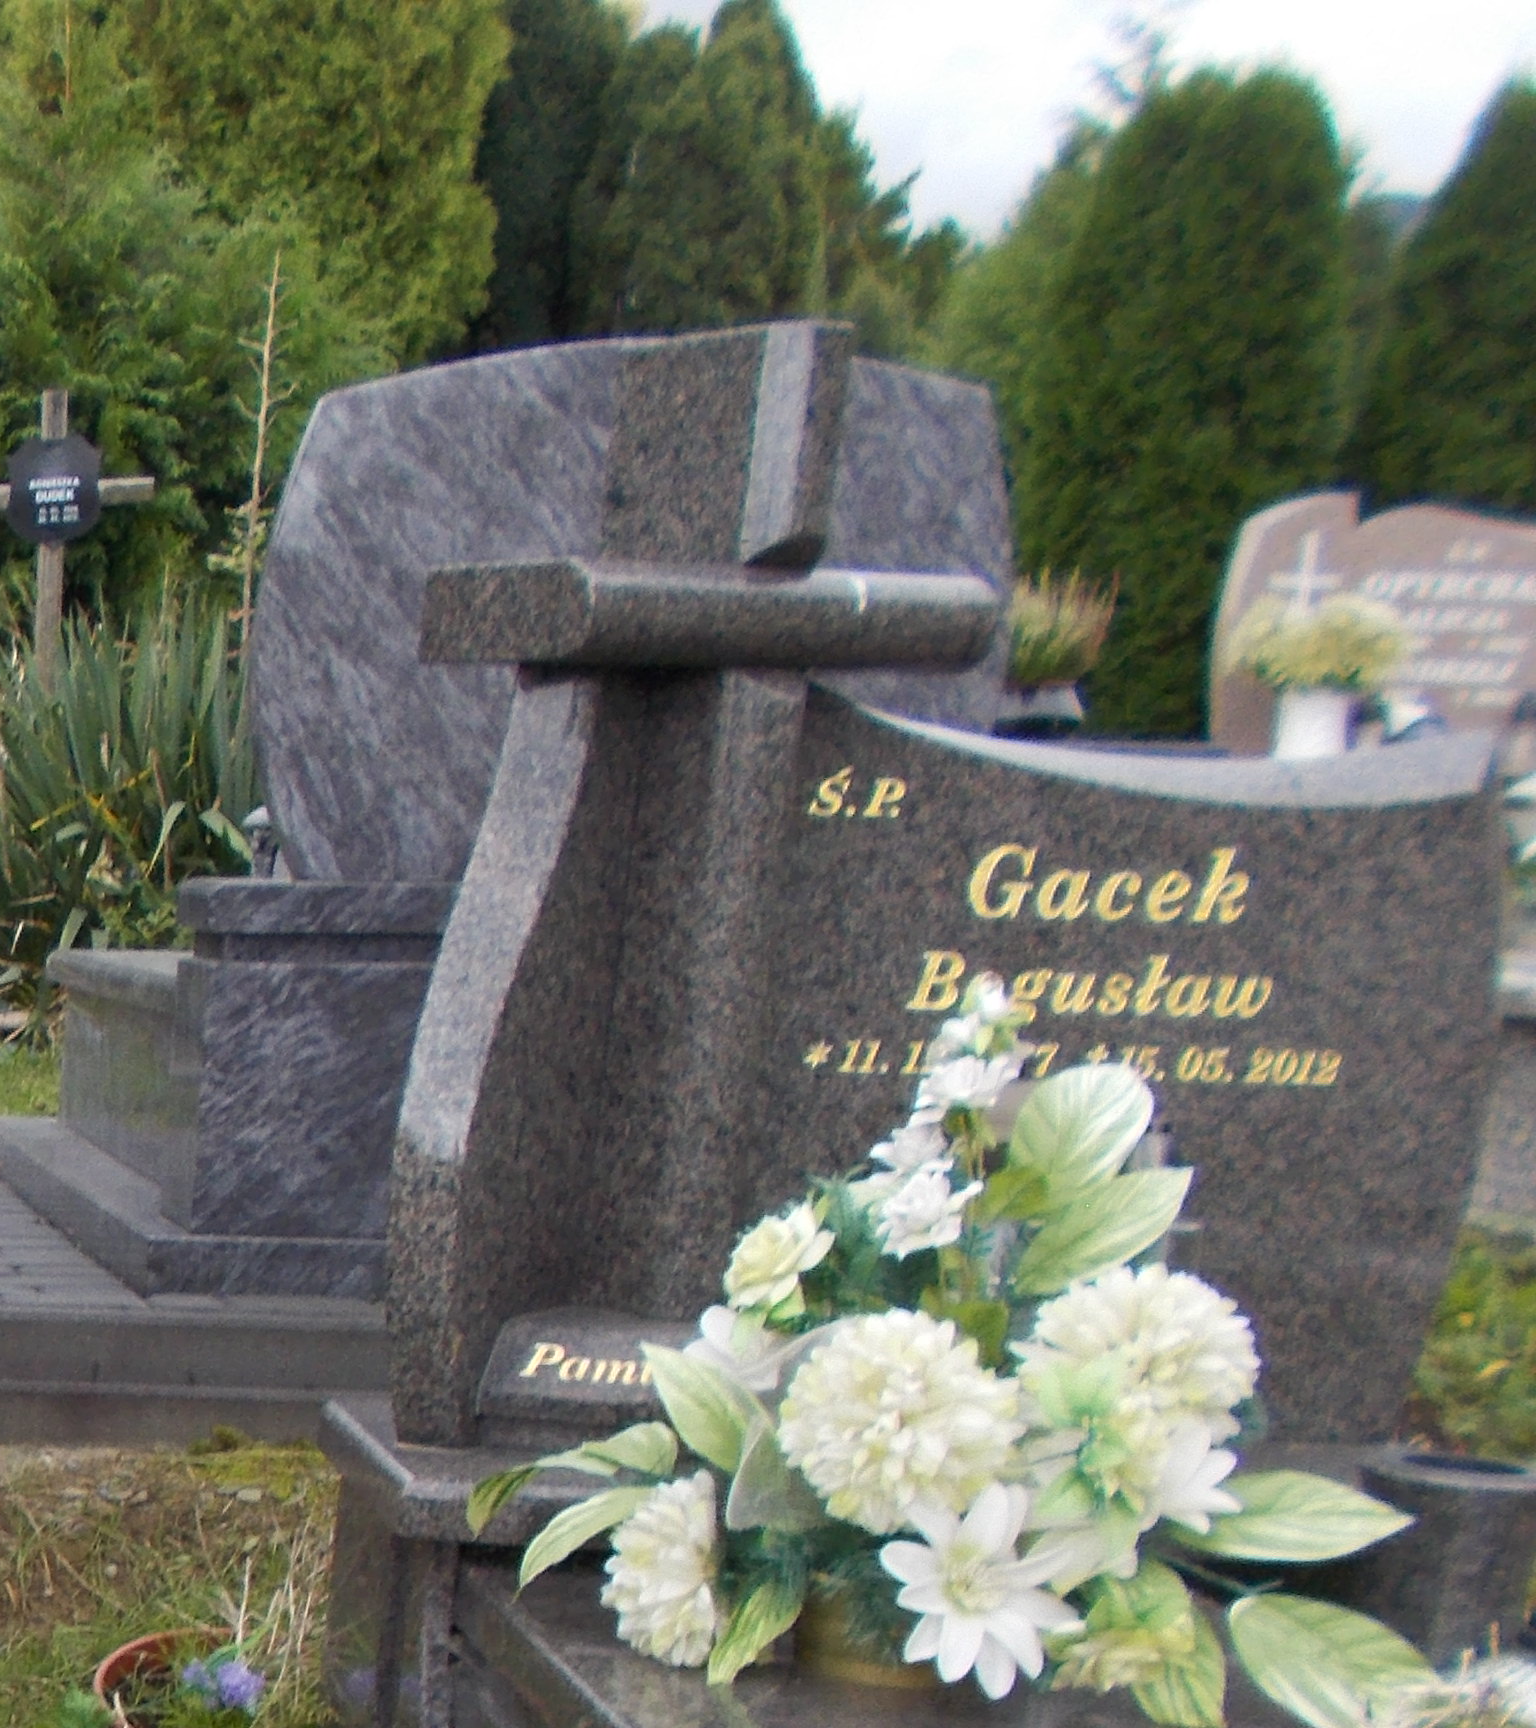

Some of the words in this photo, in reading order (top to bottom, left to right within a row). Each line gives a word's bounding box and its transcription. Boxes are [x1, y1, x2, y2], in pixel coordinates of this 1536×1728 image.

[808, 766, 907, 819] Ś.P.
[968, 842, 1251, 925] Gacek
[906, 950, 1275, 1024] Bgusław
